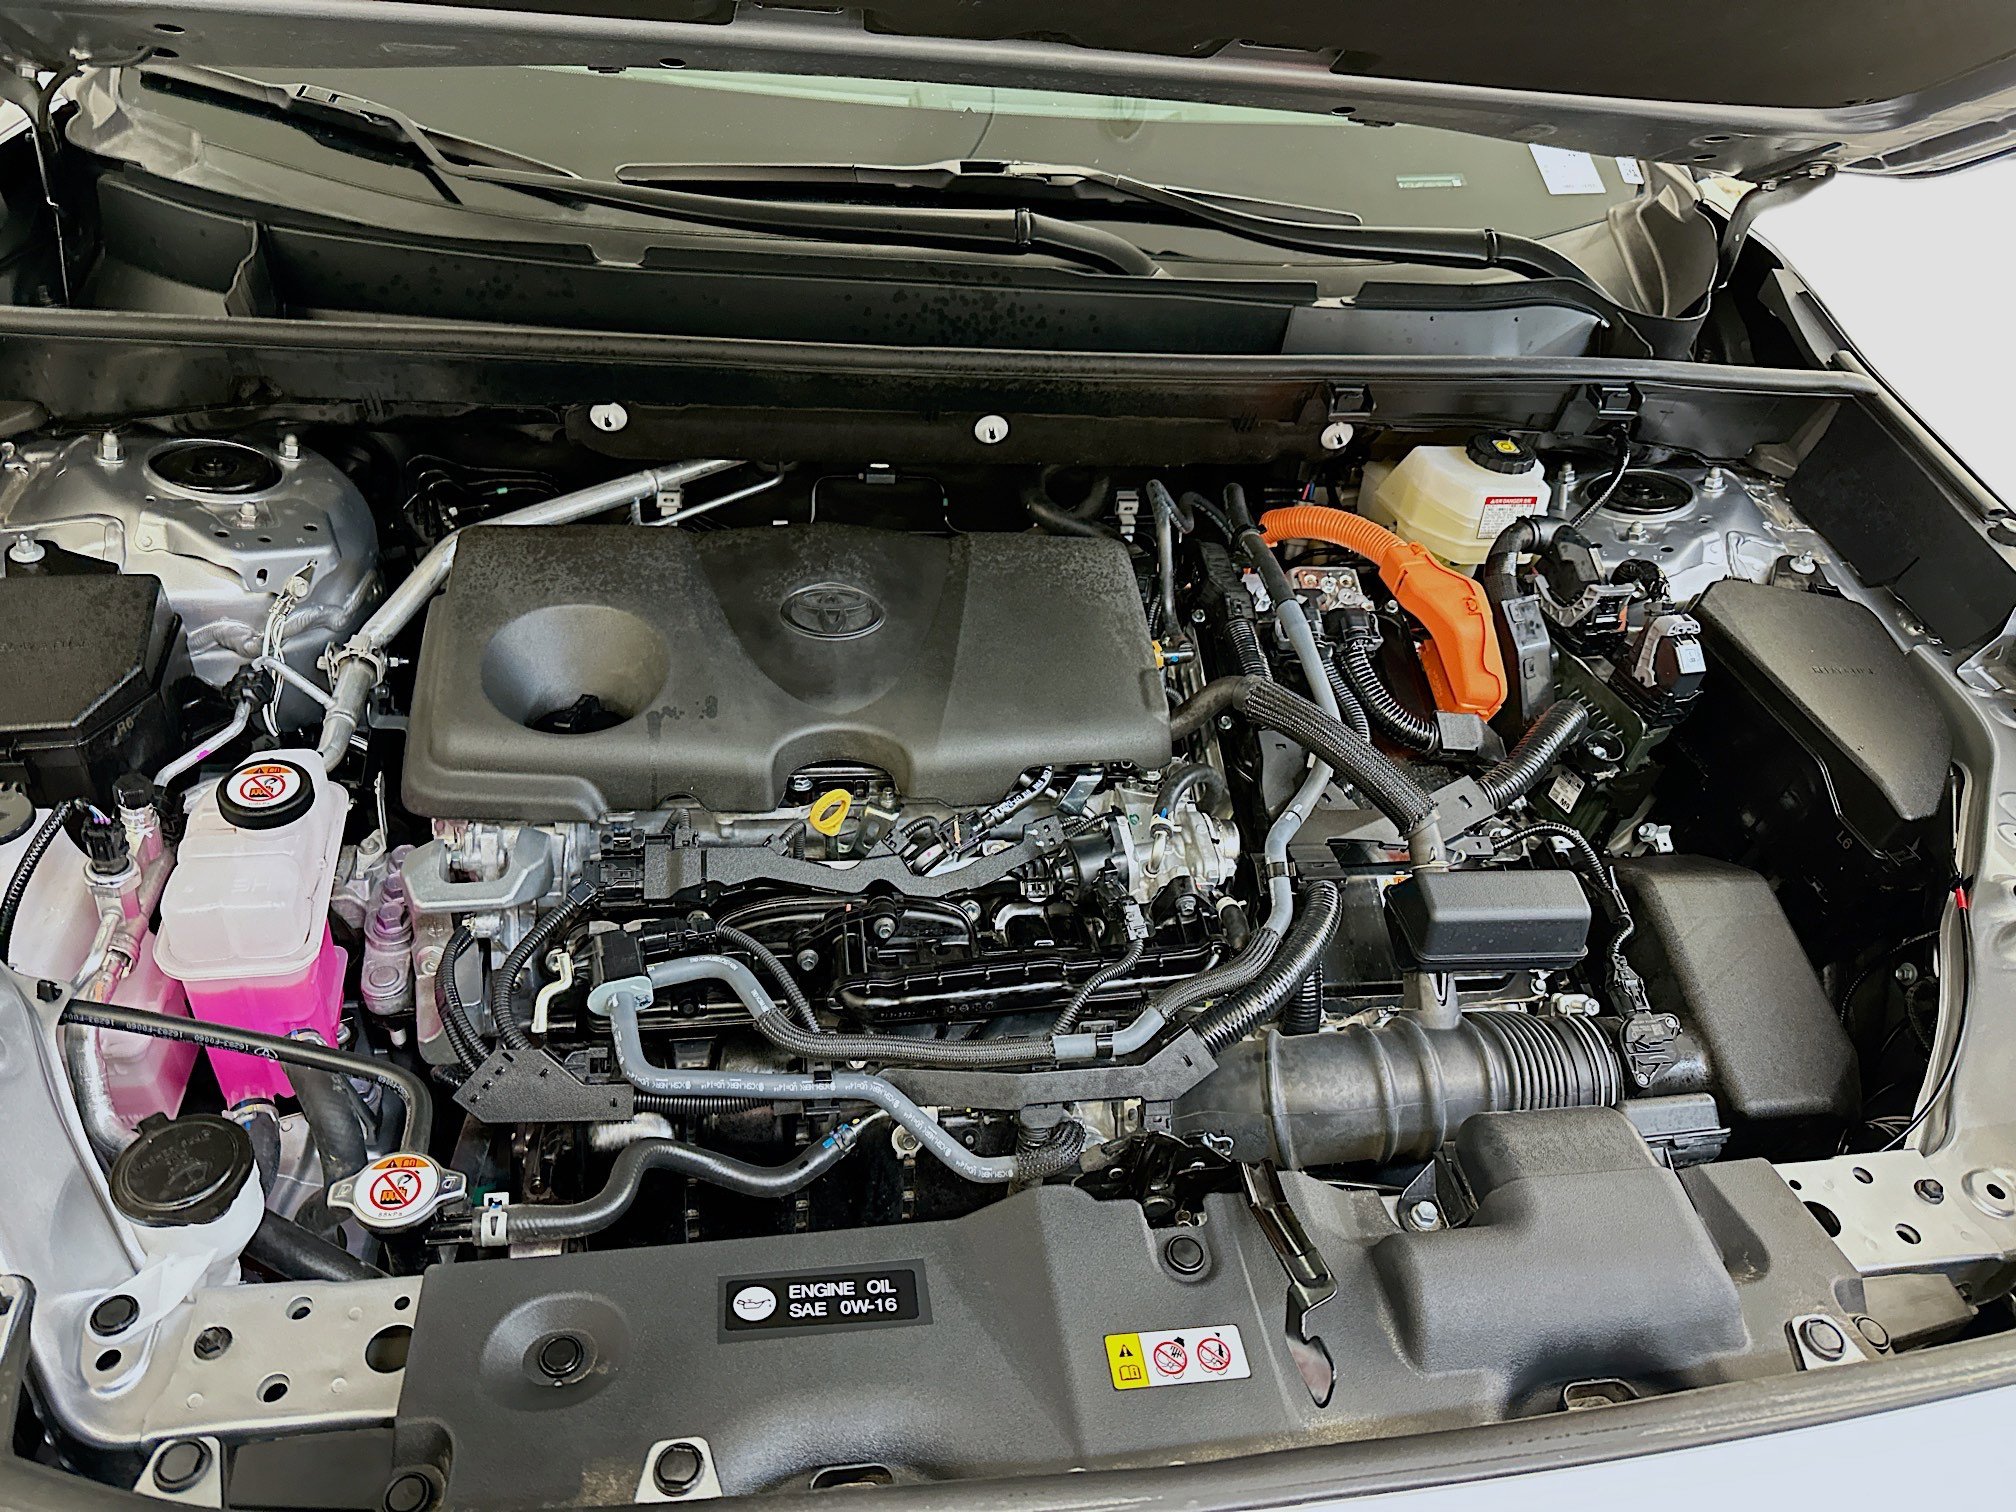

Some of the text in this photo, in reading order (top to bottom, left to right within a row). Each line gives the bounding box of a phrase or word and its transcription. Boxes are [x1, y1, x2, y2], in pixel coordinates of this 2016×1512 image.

[126, 1021, 184, 1039] 16283-F0060
[194, 1034, 250, 1051] 16283-F0060
[788, 1279, 897, 1299] ENGINE OIL
[789, 1297, 898, 1318] SAE 0W-16
